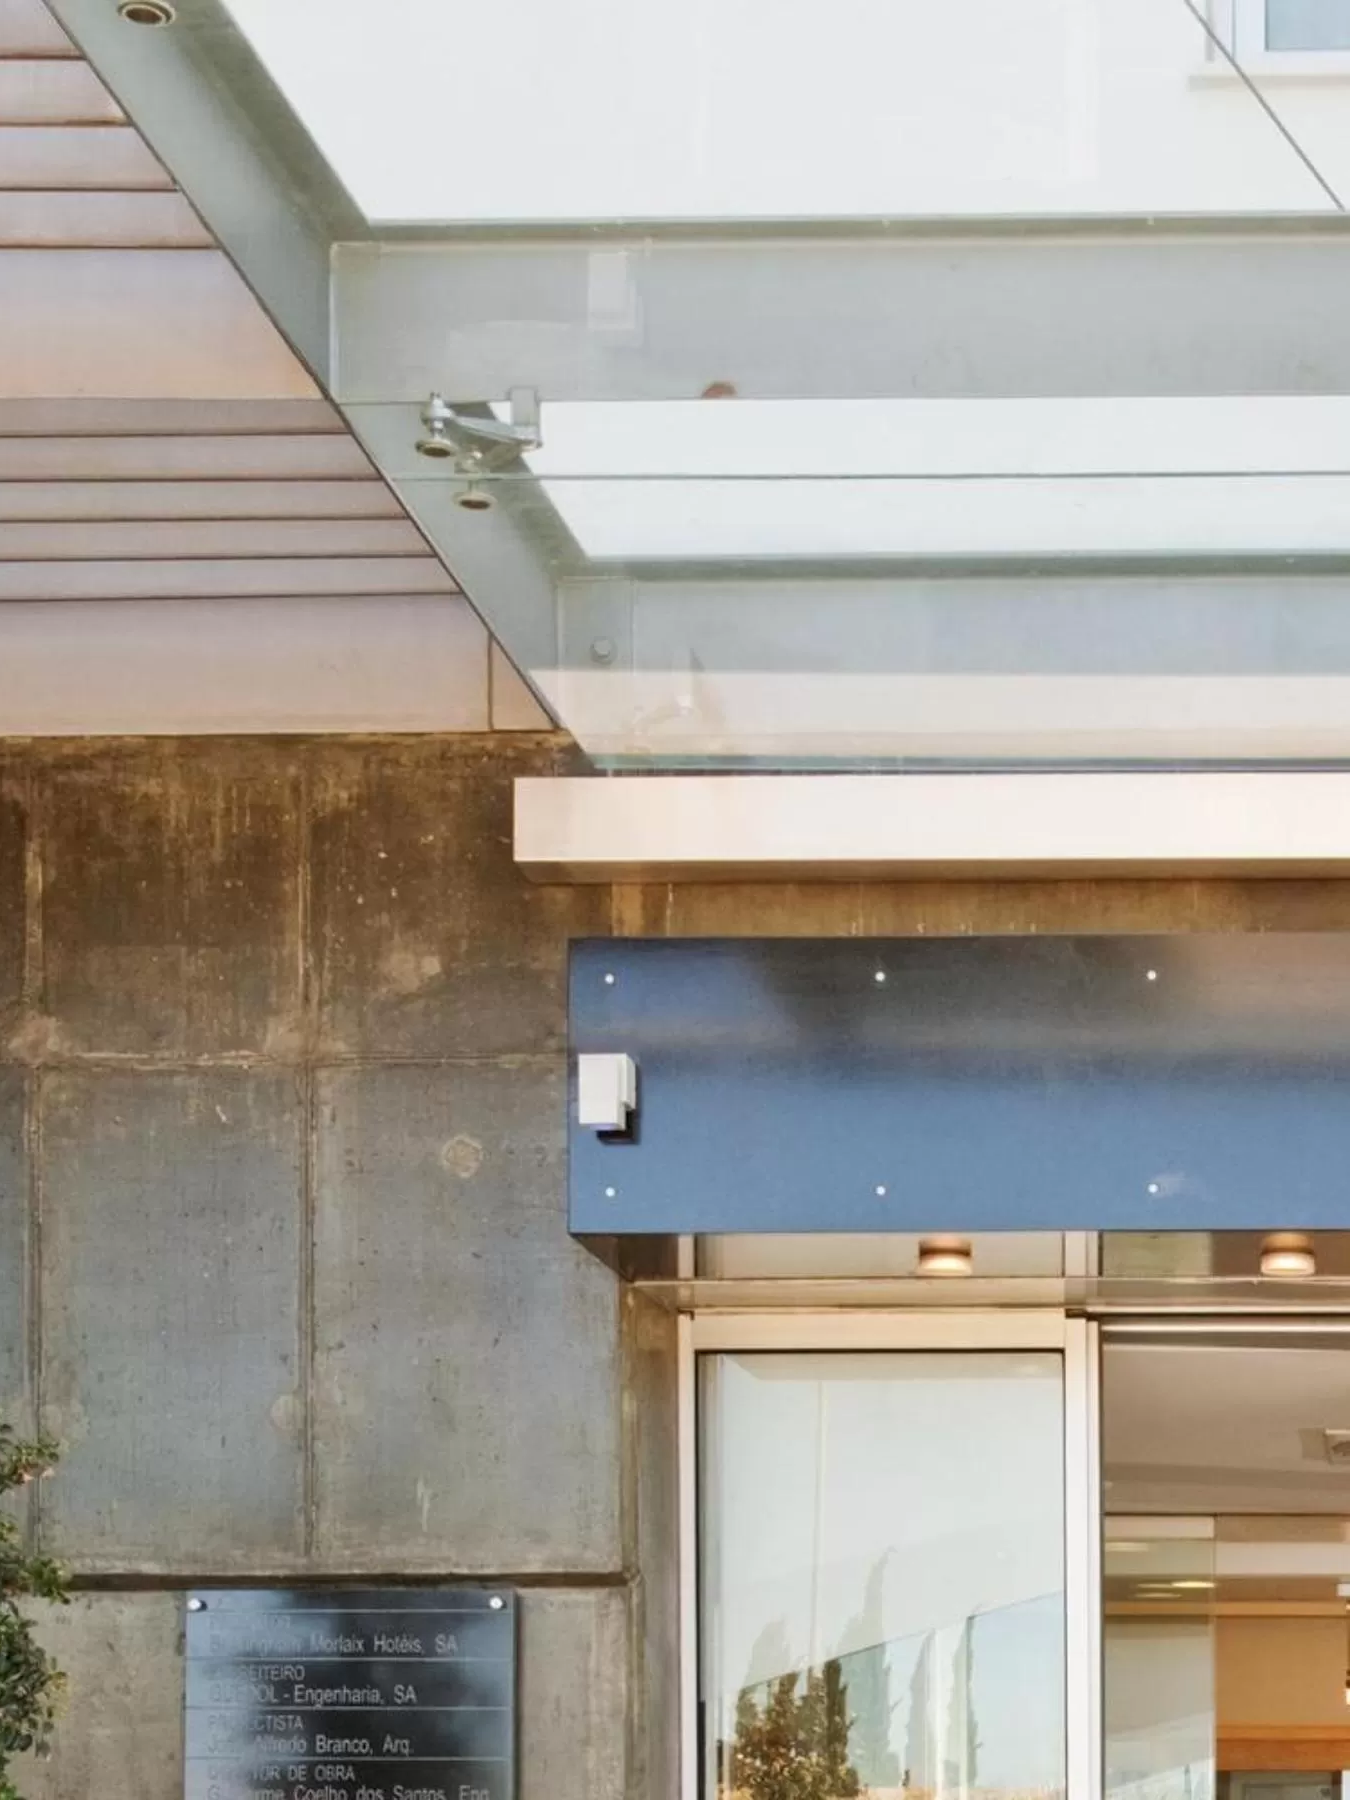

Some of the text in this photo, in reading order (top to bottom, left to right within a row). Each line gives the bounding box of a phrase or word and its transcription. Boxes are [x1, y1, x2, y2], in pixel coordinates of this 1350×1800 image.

[435, 1633, 459, 1653] SA
[393, 1684, 418, 1704] SA
[315, 1734, 374, 1755] Branco,
[288, 1764, 307, 1781] DE
[314, 1764, 356, 1781] OBRA
[293, 1785, 349, 1800] Coelho
[356, 1785, 384, 1800] dos
